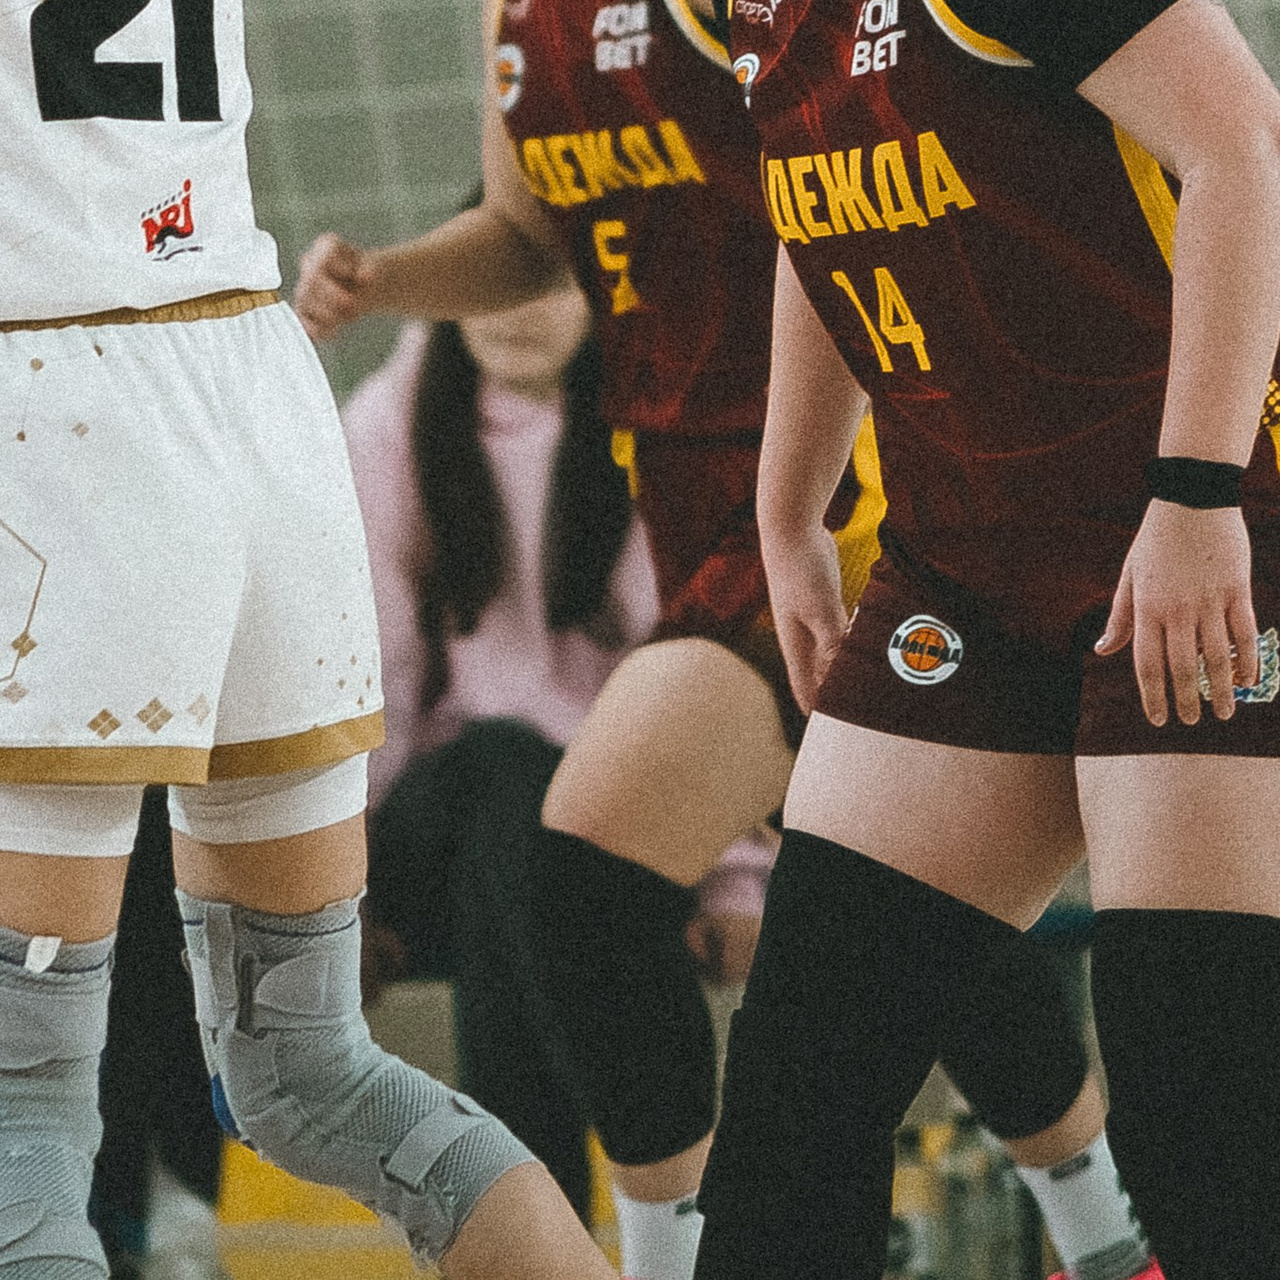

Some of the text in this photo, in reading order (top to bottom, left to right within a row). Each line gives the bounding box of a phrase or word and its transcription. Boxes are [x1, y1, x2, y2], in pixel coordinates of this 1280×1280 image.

[850, 28, 908, 78] BET
[761, 130, 978, 246] ДЕЖДА
[831, 266, 933, 374] 14
